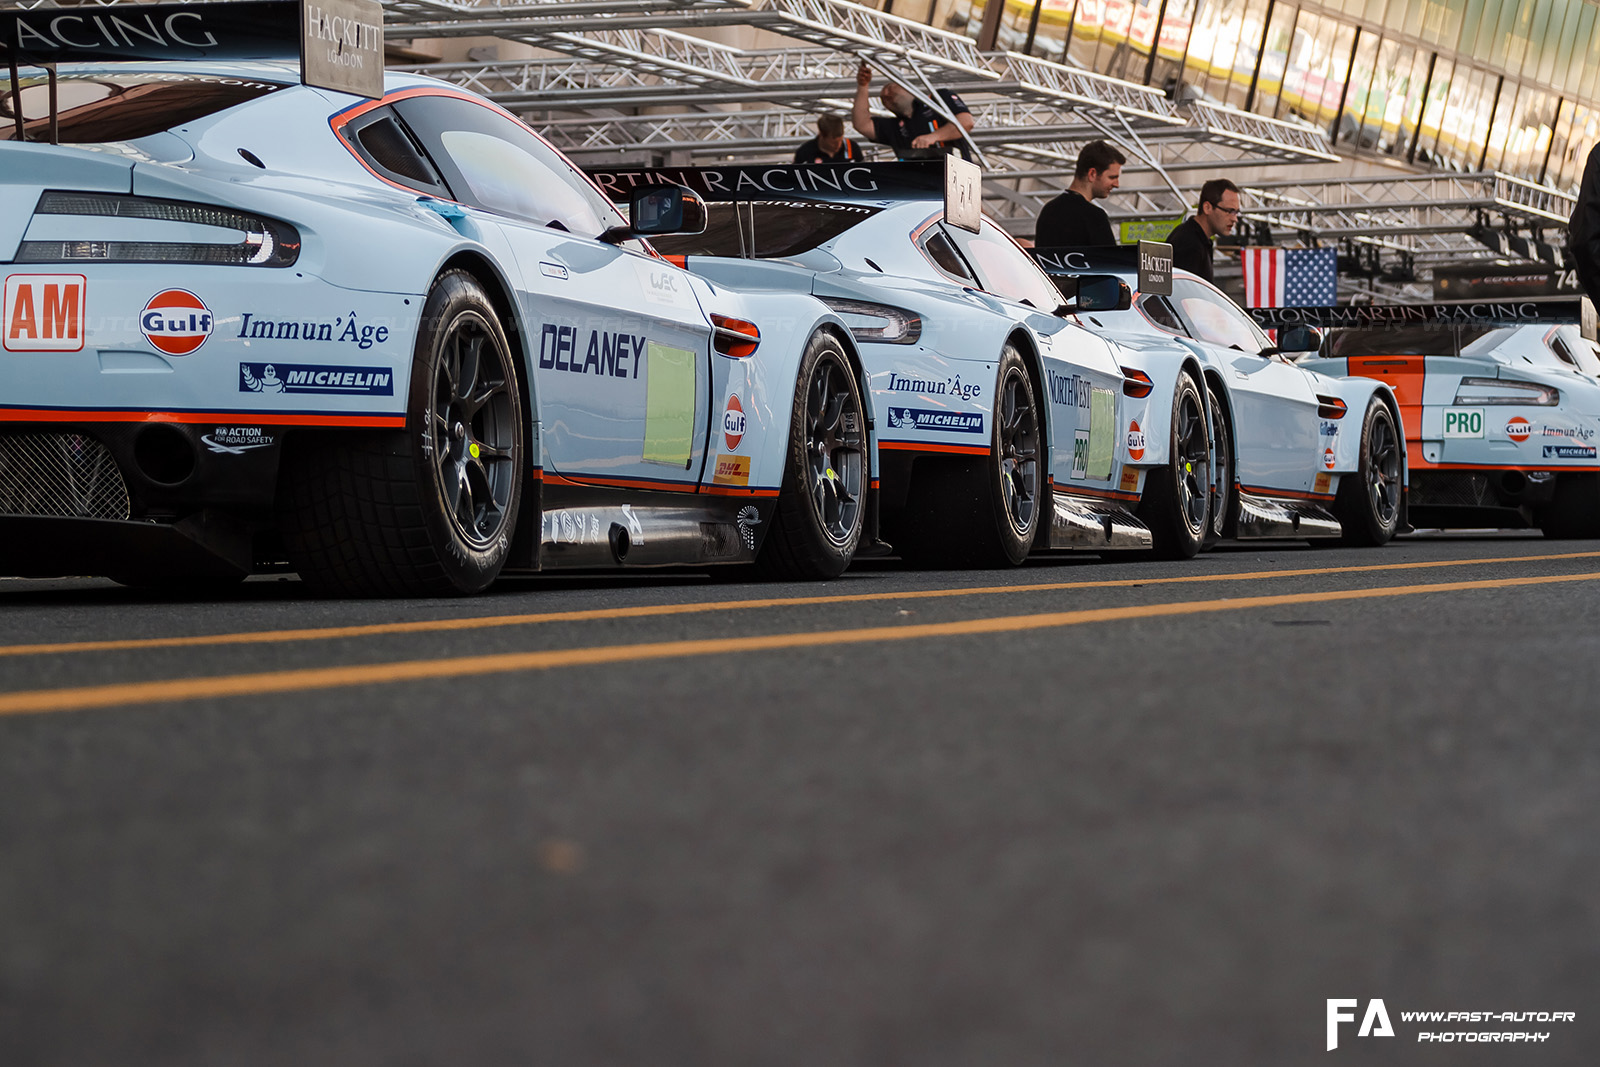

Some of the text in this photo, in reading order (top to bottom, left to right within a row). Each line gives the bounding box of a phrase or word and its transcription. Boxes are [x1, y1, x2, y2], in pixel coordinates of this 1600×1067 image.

[0, 12, 218, 48] ACING
[308, 5, 380, 53] HACKETT
[327, 48, 363, 69] LONDON
[701, 167, 879, 192] RACING
[1141, 253, 1172, 273] HACKETT
[1148, 274, 1165, 283] LONDON
[1554, 269, 1580, 290] 74
[9, 284, 80, 339] AM
[1330, 306, 1426, 320] MARTIN
[1434, 303, 1539, 319] RACING
[142, 312, 211, 332] Gulf
[237, 311, 389, 350] Immun'Âge
[539, 323, 646, 379] DELANEY
[286, 370, 390, 387] MICHELIN
[887, 374, 981, 401] Immun'Âge
[724, 413, 745, 432] Gulf
[917, 413, 982, 428] MICHELIN
[1446, 412, 1482, 434] PRO
[1506, 424, 1532, 434] Gulf
[215, 427, 262, 436] FIA ACTION
[226, 436, 246, 444] ROAD
[247, 436, 274, 444] SAFETY
[1127, 434, 1145, 447] Gulf
[1072, 438, 1088, 472] PRO
[1559, 448, 1597, 456] MICHELIN
